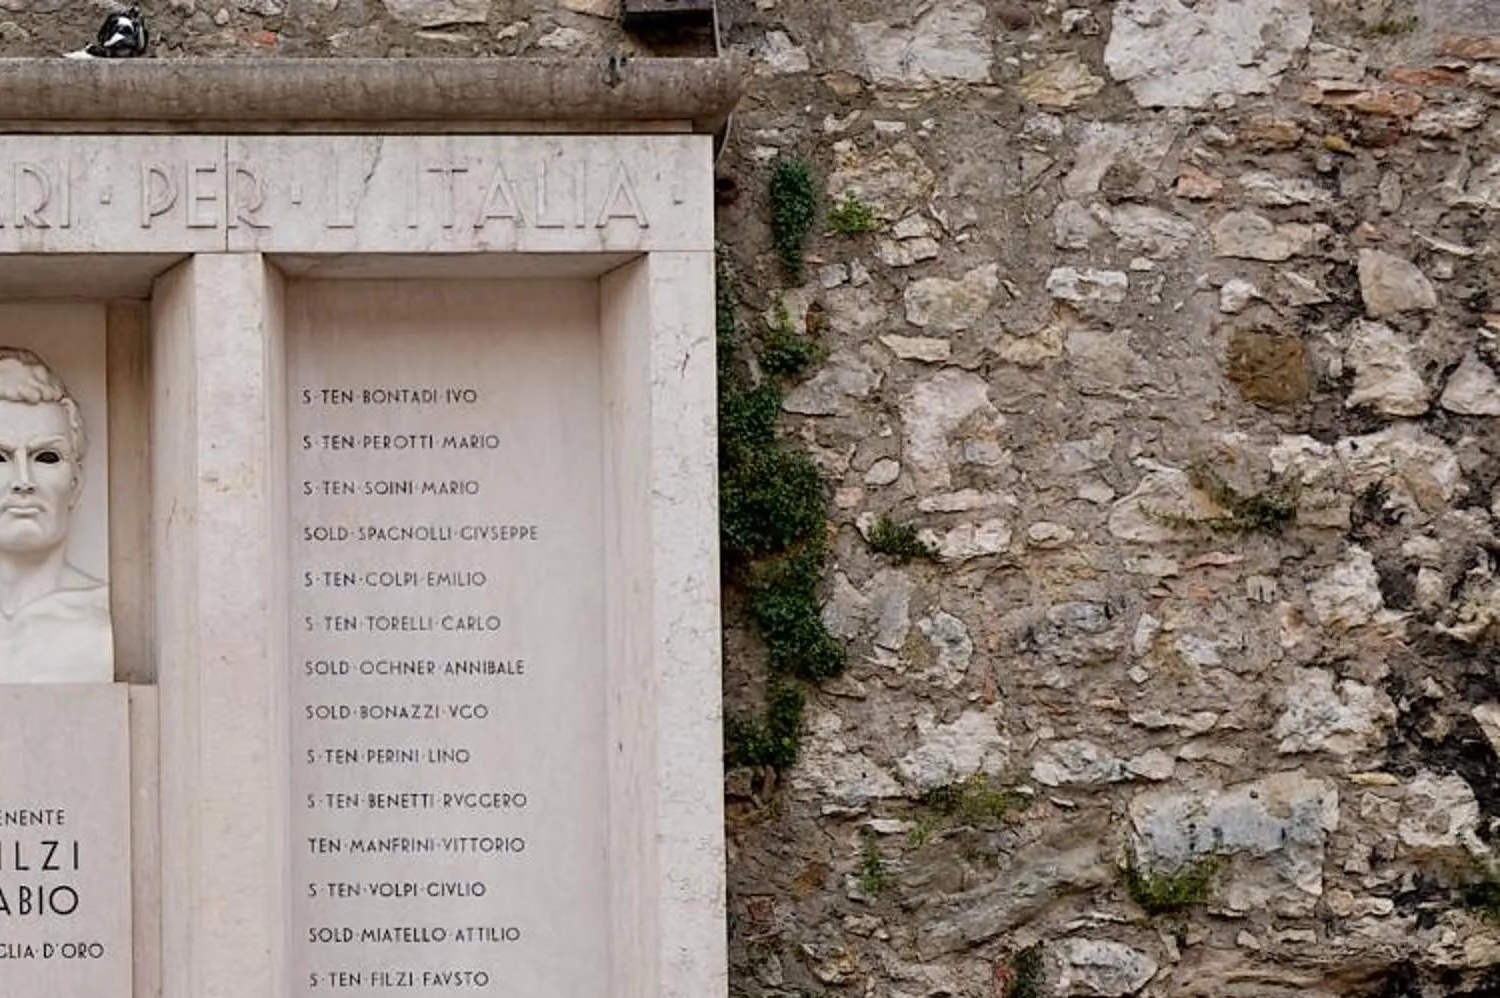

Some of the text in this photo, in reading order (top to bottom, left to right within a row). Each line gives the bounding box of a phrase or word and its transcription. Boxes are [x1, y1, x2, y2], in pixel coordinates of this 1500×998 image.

[138, 160, 272, 230] PER
[301, 389, 478, 405] S TEN BONTADI IVO
[301, 434, 501, 450] S TEN PEROTTI MARIO
[301, 480, 481, 496] S TEN SOINI MARIO
[303, 525, 349, 541] SOLD
[303, 571, 487, 588] S TEN COLPI EMILIO
[304, 615, 502, 632] S TEN TORELLI CARLO
[304, 660, 526, 676] SOLD OCHNER ANNIBALE
[305, 704, 351, 720] SOLD
[358, 704, 441, 720] BONAZZI
[306, 749, 471, 765] S TEN PERINI LINO
[306, 793, 317, 810] S
[324, 793, 360, 810] TEN
[367, 793, 435, 810] BENETTI
[307, 837, 526, 854] TEN MANFRINI VITTORIO
[306, 882, 318, 898] S
[326, 882, 361, 898] TEN
[367, 882, 418, 898] VOLPI
[308, 927, 521, 943] SOLD MIATELLO ATTILIO
[42, 943, 105, 961] D'ORO
[308, 971, 490, 988] S TEN FILZI FAVSTO
